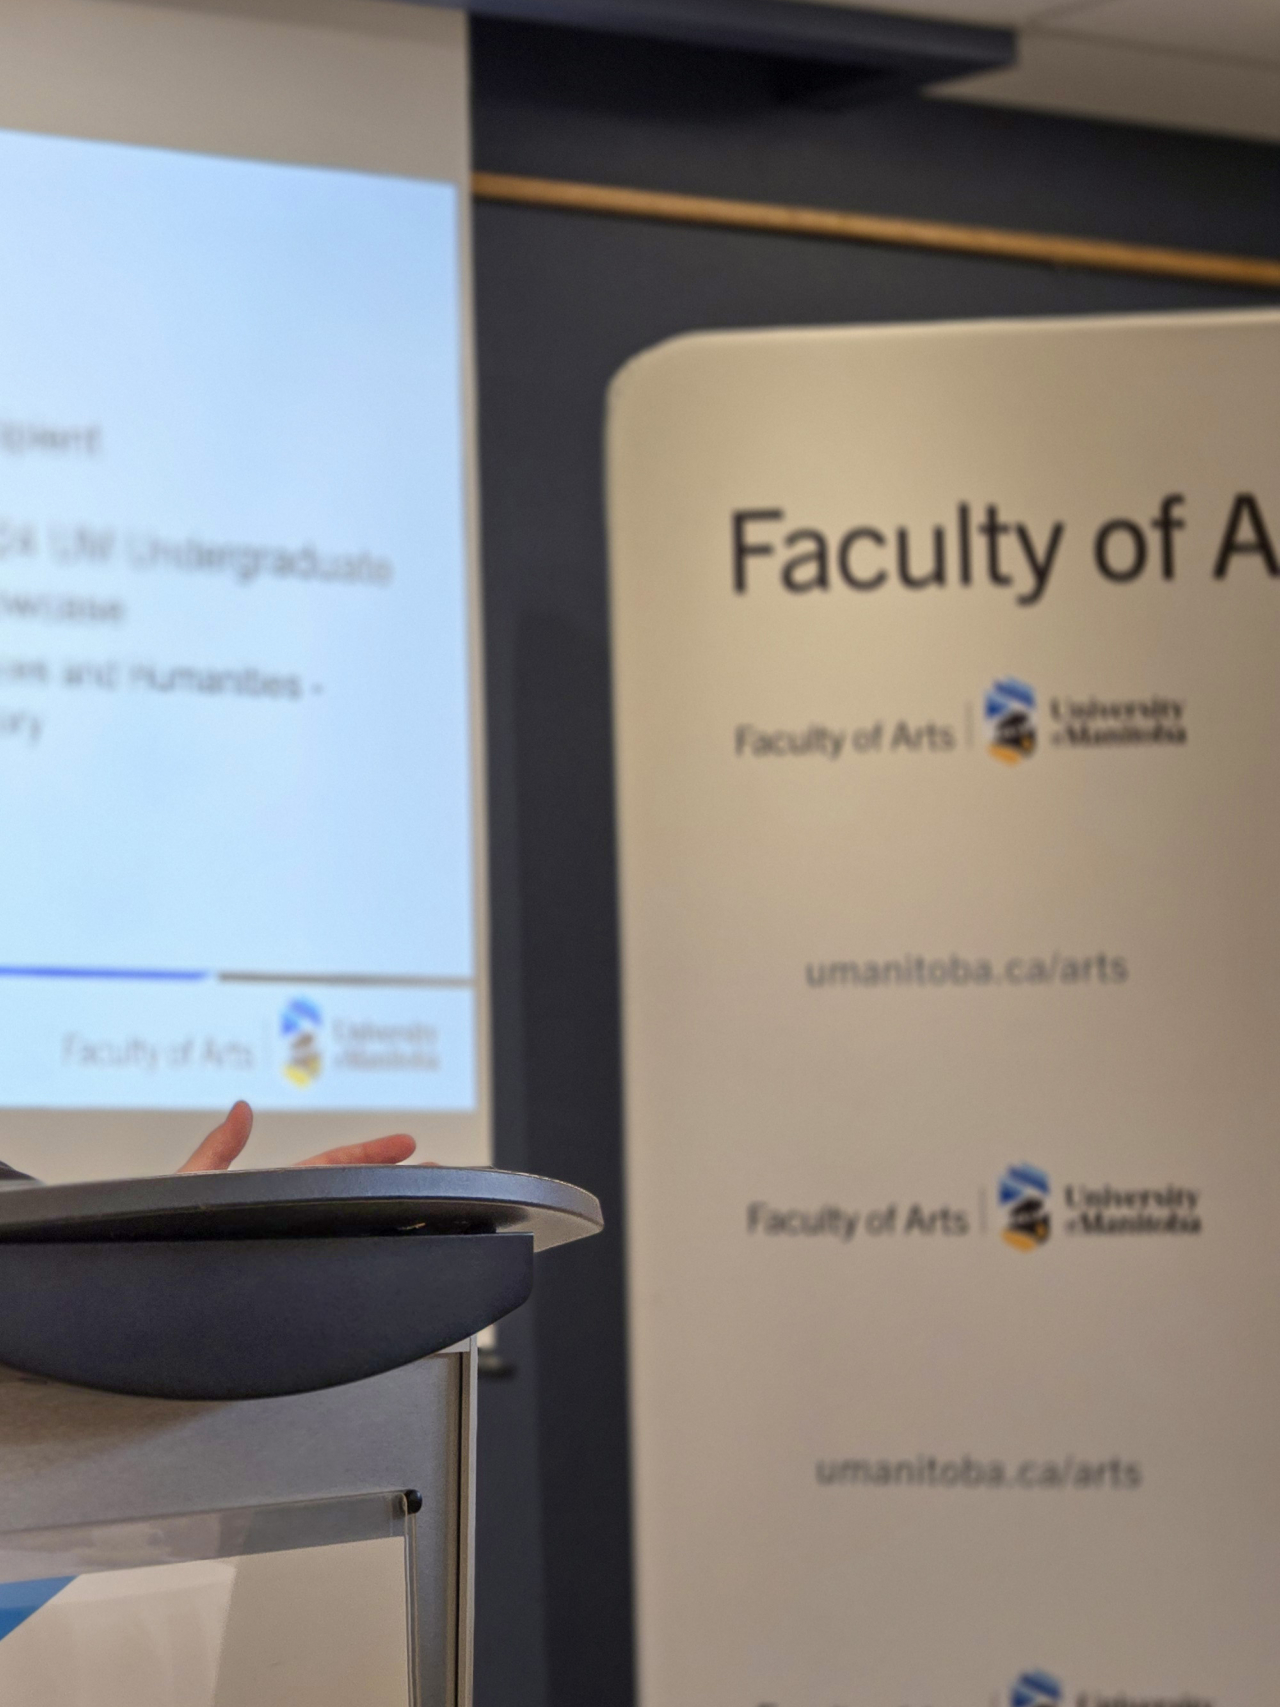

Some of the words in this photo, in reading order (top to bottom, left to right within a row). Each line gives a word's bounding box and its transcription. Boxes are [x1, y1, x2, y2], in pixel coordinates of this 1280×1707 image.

[125, 527, 396, 588] Undergraduate
[731, 499, 1065, 607] Faculty
[1092, 492, 1187, 584] of
[1212, 491, 1280, 580] A
[63, 650, 117, 692] and
[127, 657, 304, 702] Humanities
[1050, 694, 1186, 723] University
[734, 722, 847, 760] Faculty
[852, 722, 886, 753] of
[889, 719, 956, 753] Arts
[805, 949, 1130, 990] umanitoba.ca/arts
[62, 1031, 159, 1075] Faculty
[202, 1034, 257, 1070] Arts
[747, 1201, 859, 1243] Faculty
[865, 1202, 899, 1237] of
[903, 1204, 971, 1237] Arts
[816, 1451, 1144, 1491] umanitoba.ca/arts
